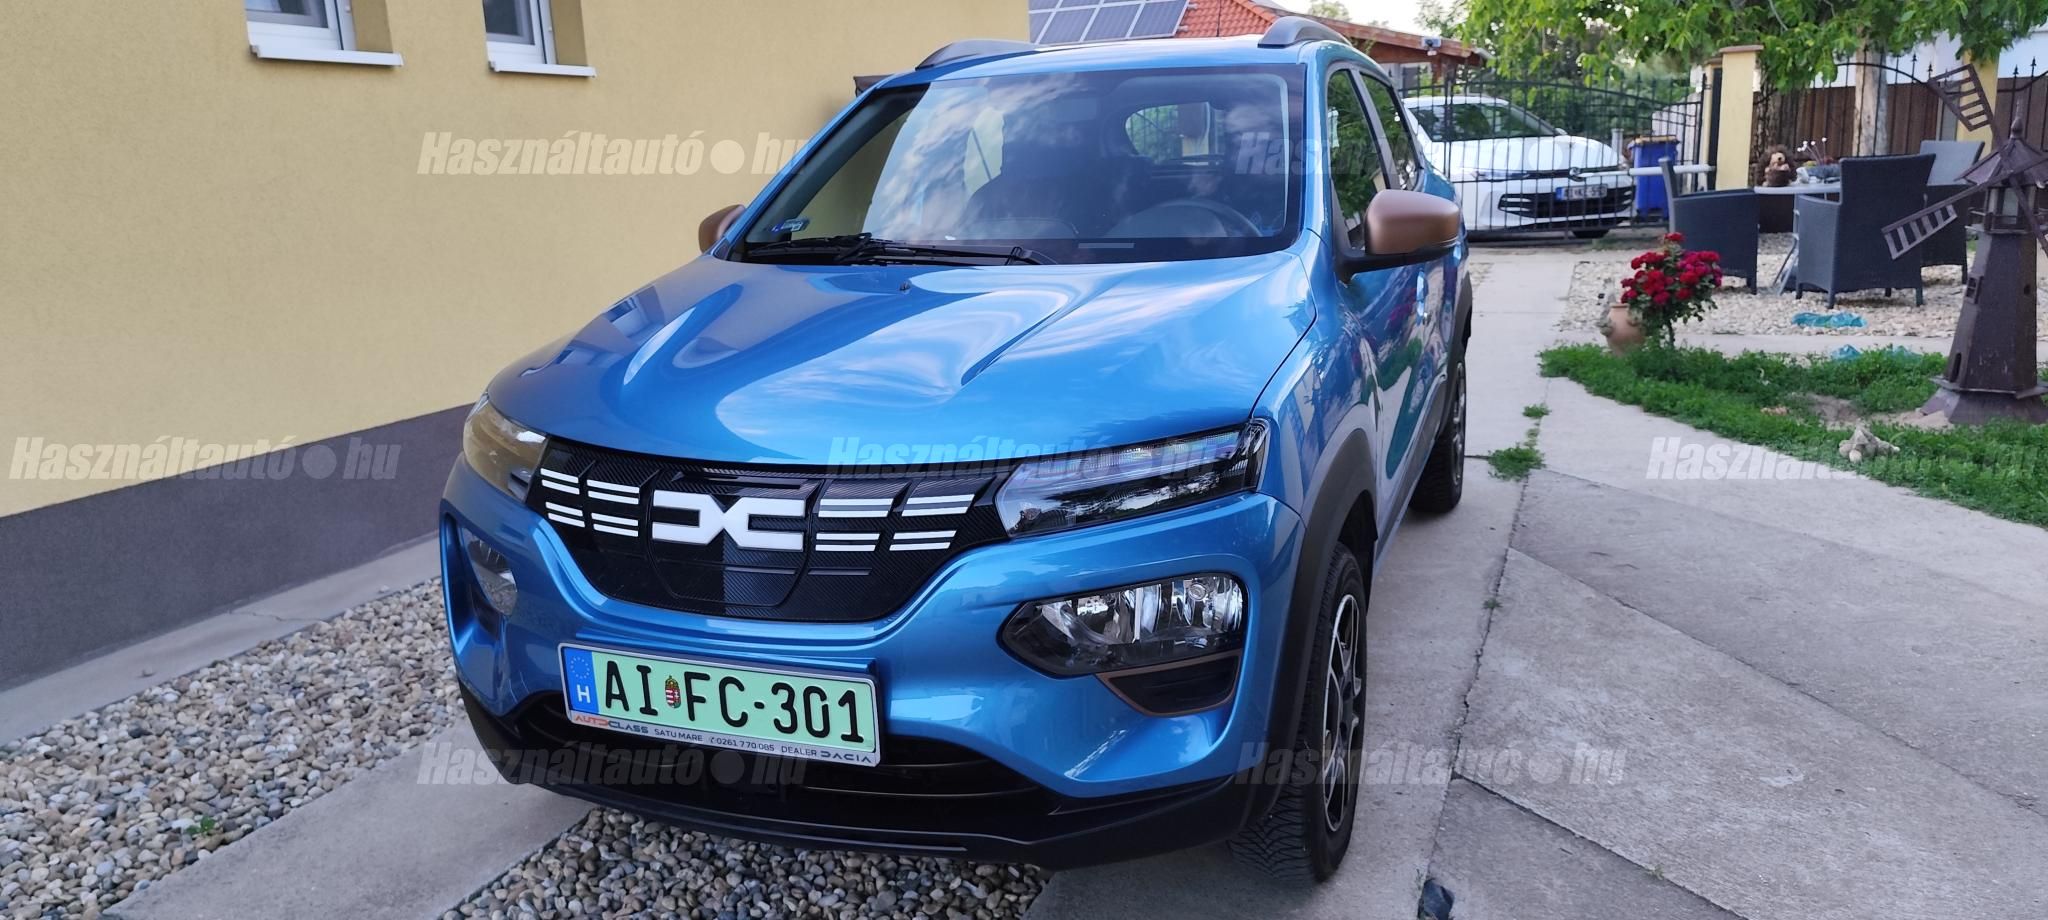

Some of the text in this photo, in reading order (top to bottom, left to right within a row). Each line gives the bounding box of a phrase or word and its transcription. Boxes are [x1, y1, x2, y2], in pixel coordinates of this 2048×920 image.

[577, 684, 591, 704] H
[605, 660, 864, 743] AI FC-301
[654, 728, 677, 738] SATU
[678, 732, 703, 742] MARE
[781, 745, 817, 757] DEALER
[820, 751, 872, 763] DACIA
